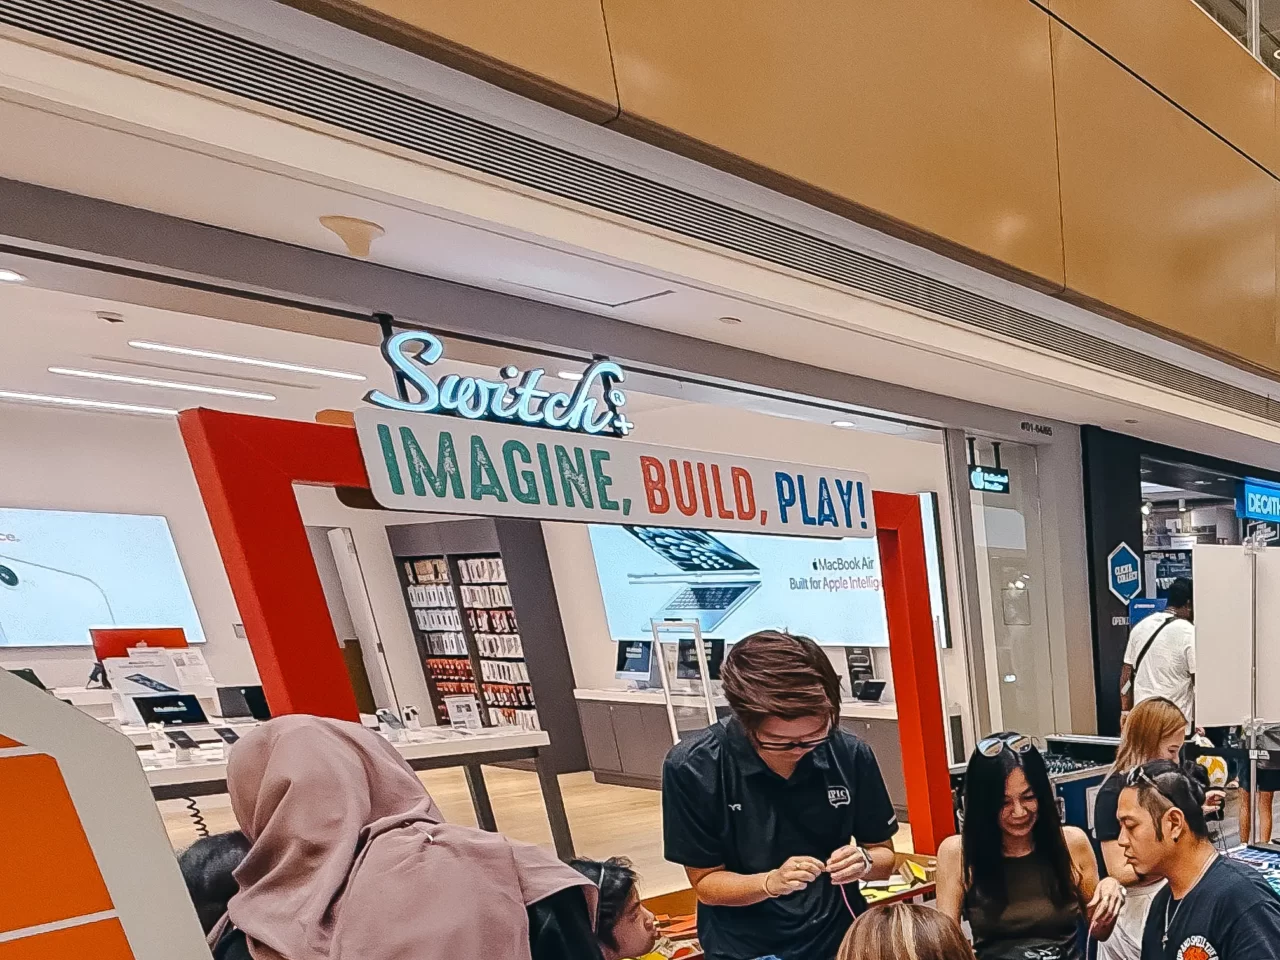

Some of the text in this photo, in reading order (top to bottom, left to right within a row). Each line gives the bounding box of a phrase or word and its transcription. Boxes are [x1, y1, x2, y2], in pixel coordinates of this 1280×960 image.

[370, 330, 625, 434] Switch
[377, 423, 869, 530] IMAGINE, BUILD, PLAY!
[789, 577, 809, 590] Built
[810, 577, 822, 590] for
[823, 577, 849, 592] Apple
[818, 556, 875, 571] MacBook Air
